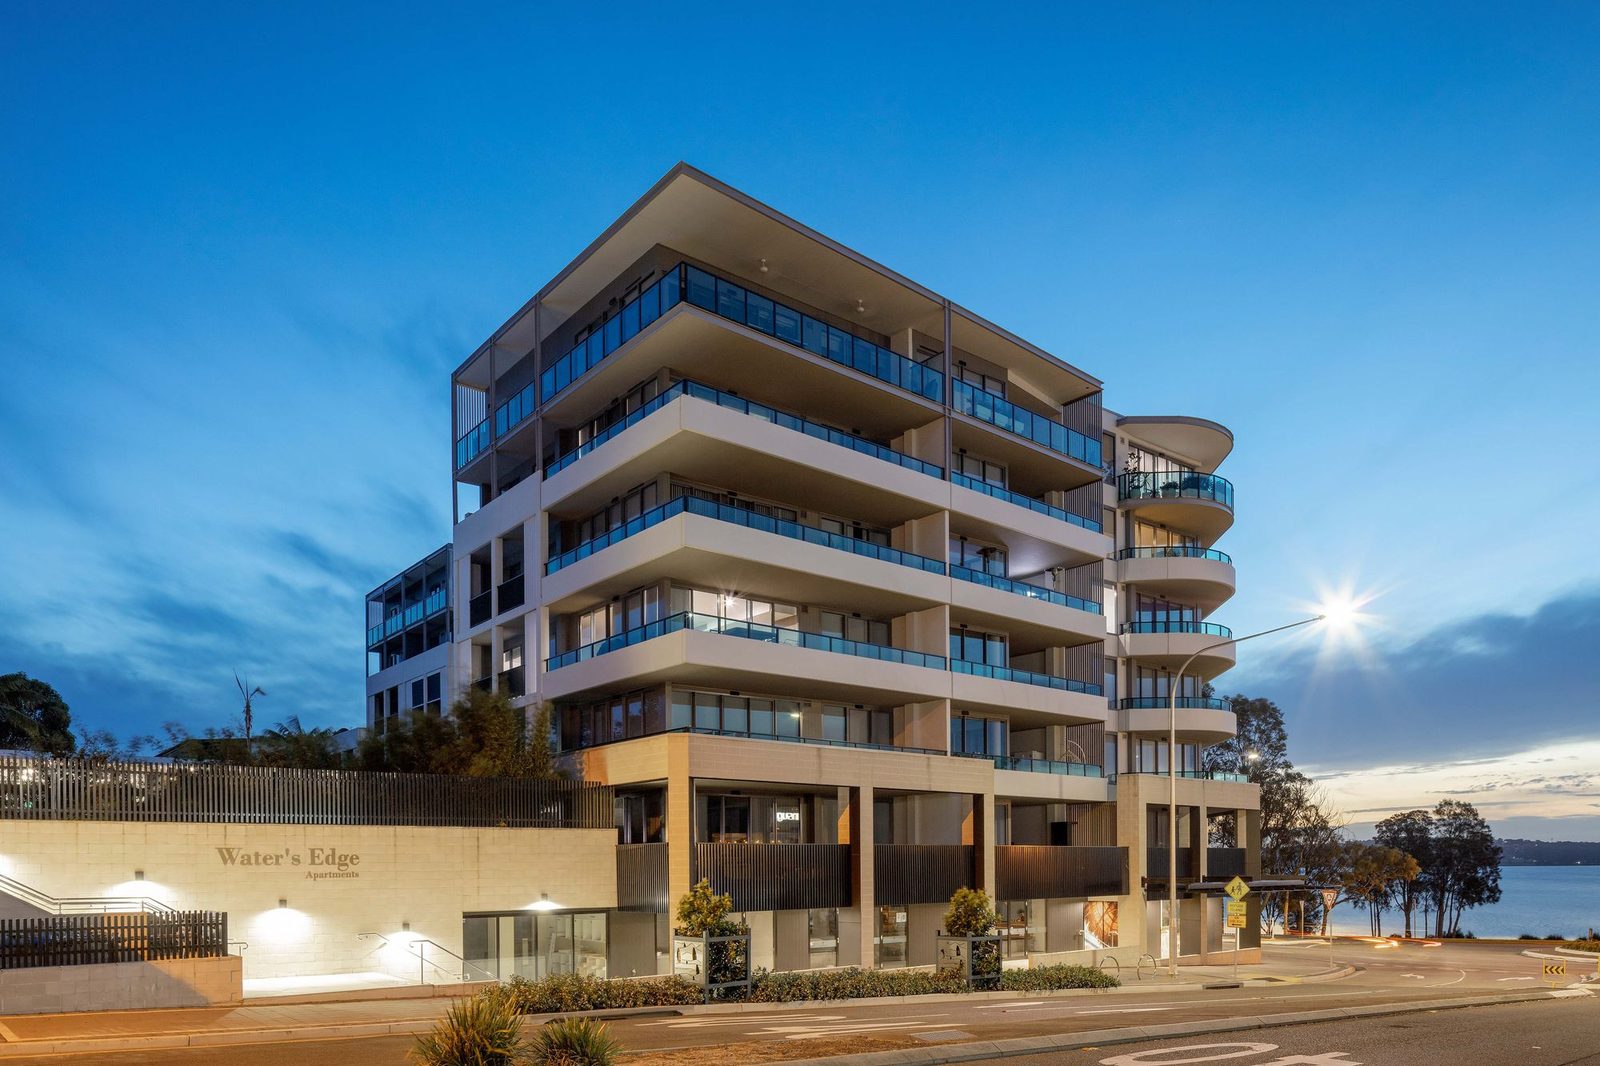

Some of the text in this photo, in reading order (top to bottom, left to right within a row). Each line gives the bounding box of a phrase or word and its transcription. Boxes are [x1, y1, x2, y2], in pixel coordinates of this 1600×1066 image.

[215, 847, 360, 872] Water's Edge
[305, 871, 359, 881] Apartments
